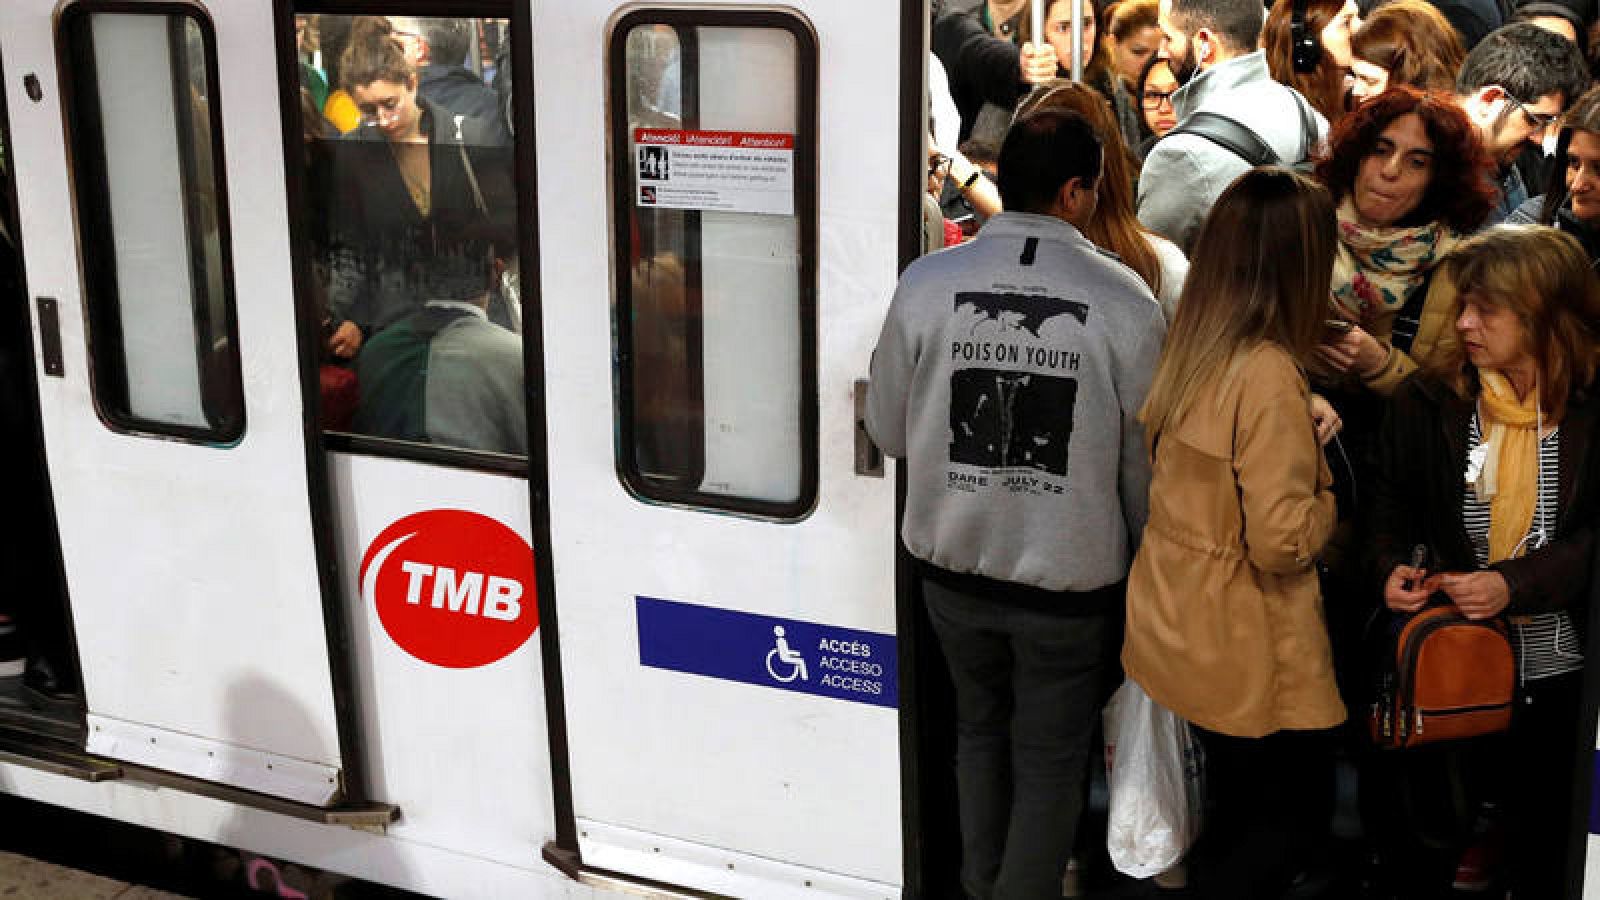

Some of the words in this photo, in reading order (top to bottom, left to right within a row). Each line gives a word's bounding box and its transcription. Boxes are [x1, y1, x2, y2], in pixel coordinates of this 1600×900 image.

[1026, 345, 1081, 370] YOUTH
[401, 560, 523, 622] TMB
[820, 656, 882, 677] ACCESO
[822, 674, 881, 694] ACCESS
